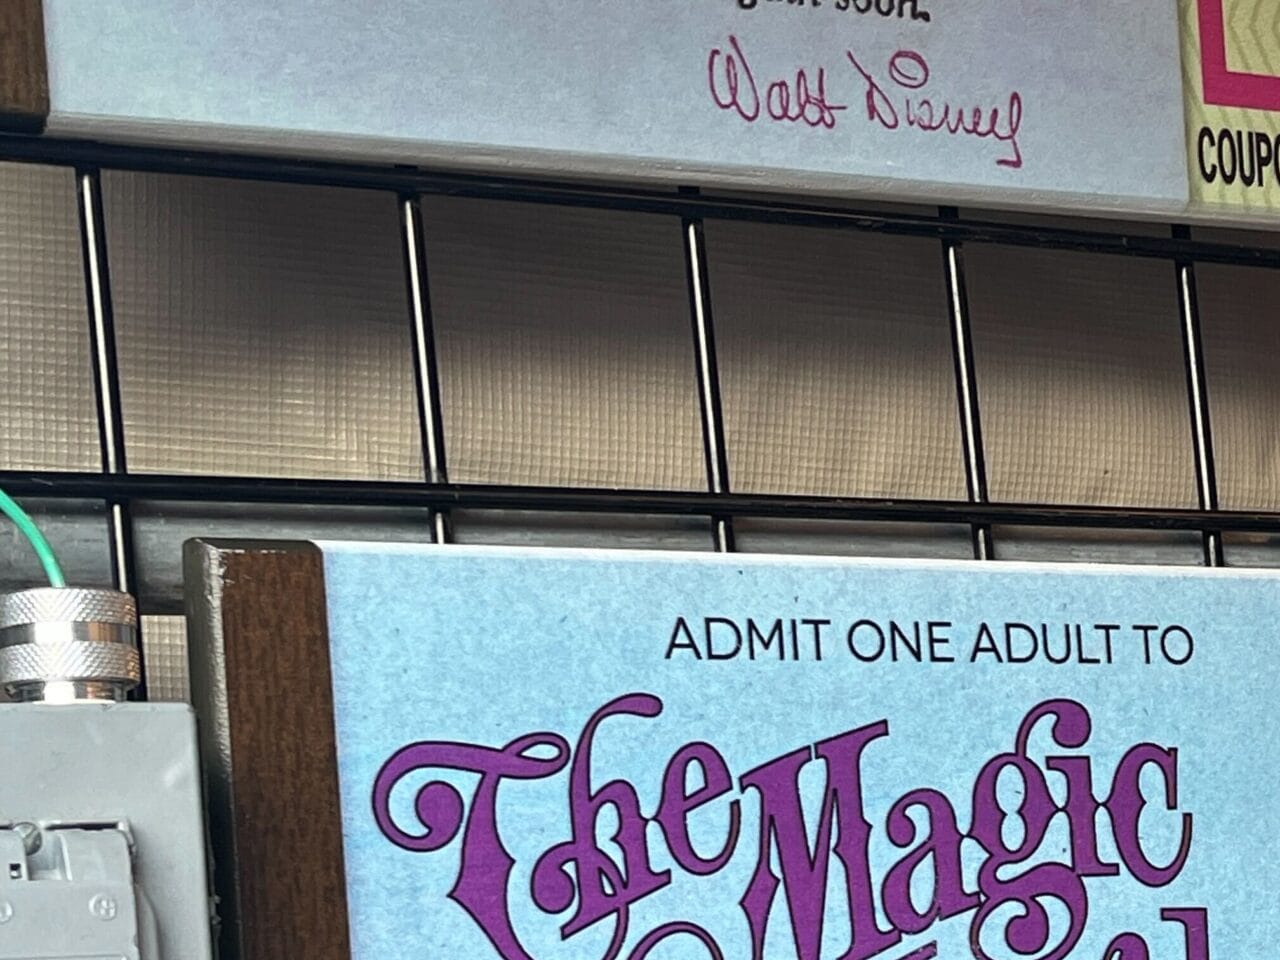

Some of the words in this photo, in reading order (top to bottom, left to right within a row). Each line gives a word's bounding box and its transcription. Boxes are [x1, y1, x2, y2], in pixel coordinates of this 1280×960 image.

[708, 35, 847, 128] Walt
[848, 50, 1022, 168] Disney
[664, 617, 831, 662] ADMIT
[847, 619, 955, 663] ONE
[969, 622, 1121, 665] ADULT
[1132, 624, 1194, 666] TO
